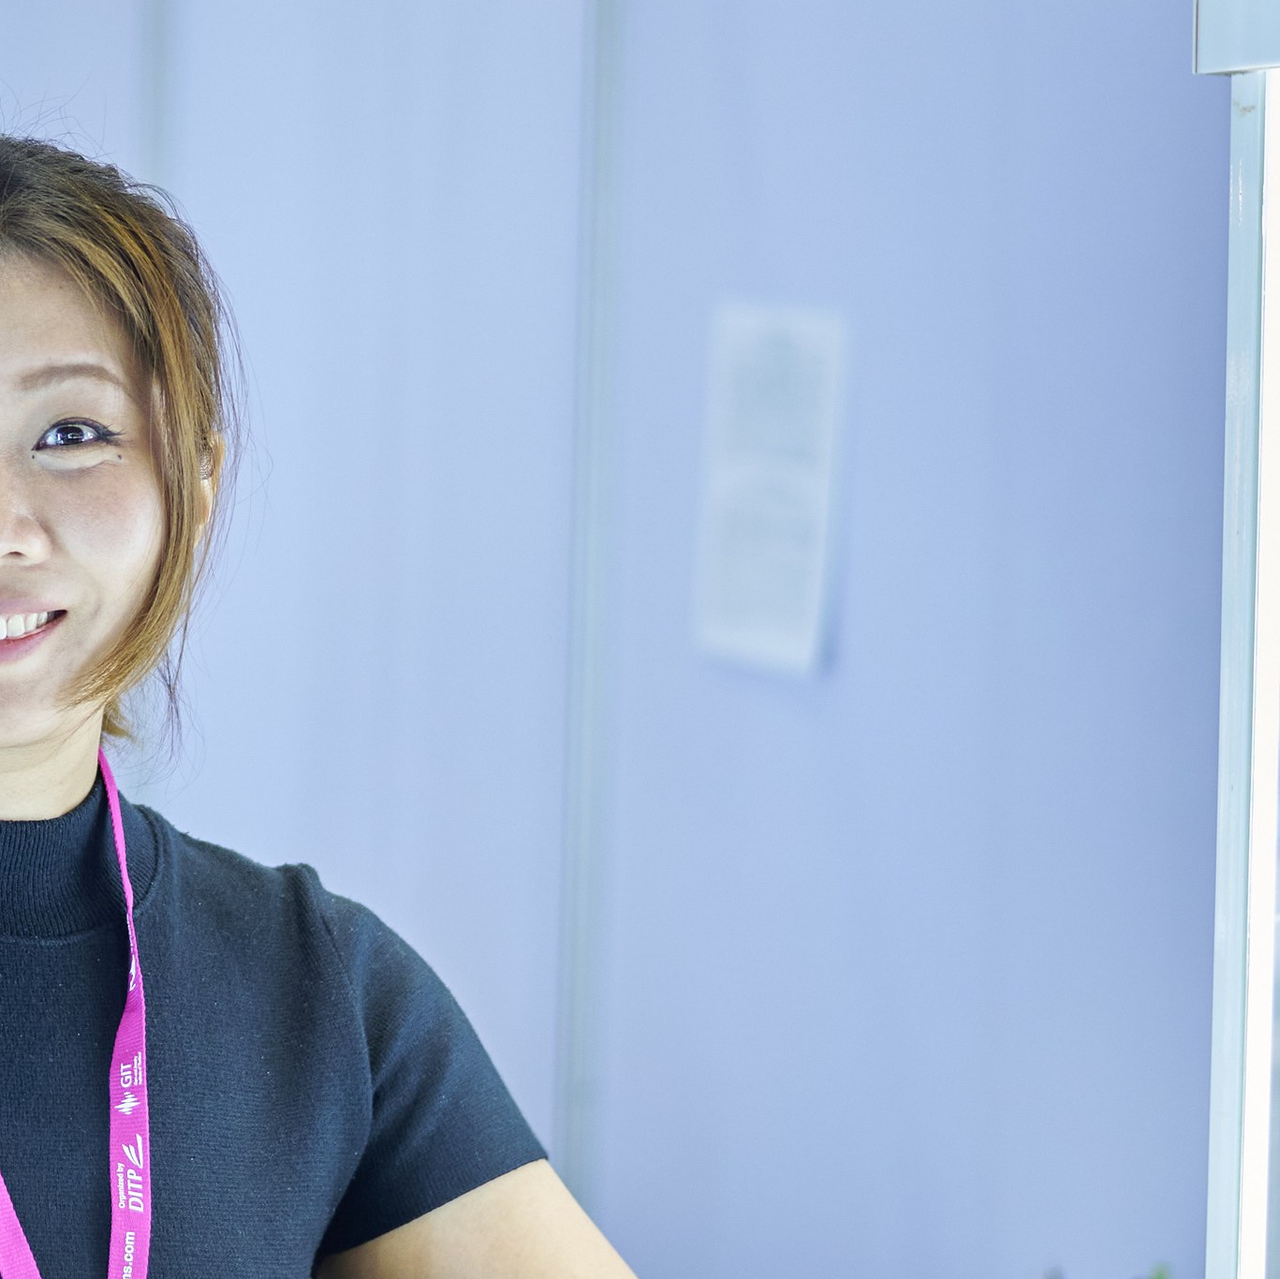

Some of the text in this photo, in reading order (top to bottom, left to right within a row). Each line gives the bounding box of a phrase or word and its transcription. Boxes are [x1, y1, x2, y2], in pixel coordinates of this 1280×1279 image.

[120, 1063, 132, 1088] GIT
[116, 1163, 126, 1209] Organized by
[127, 1169, 144, 1212] DITP
